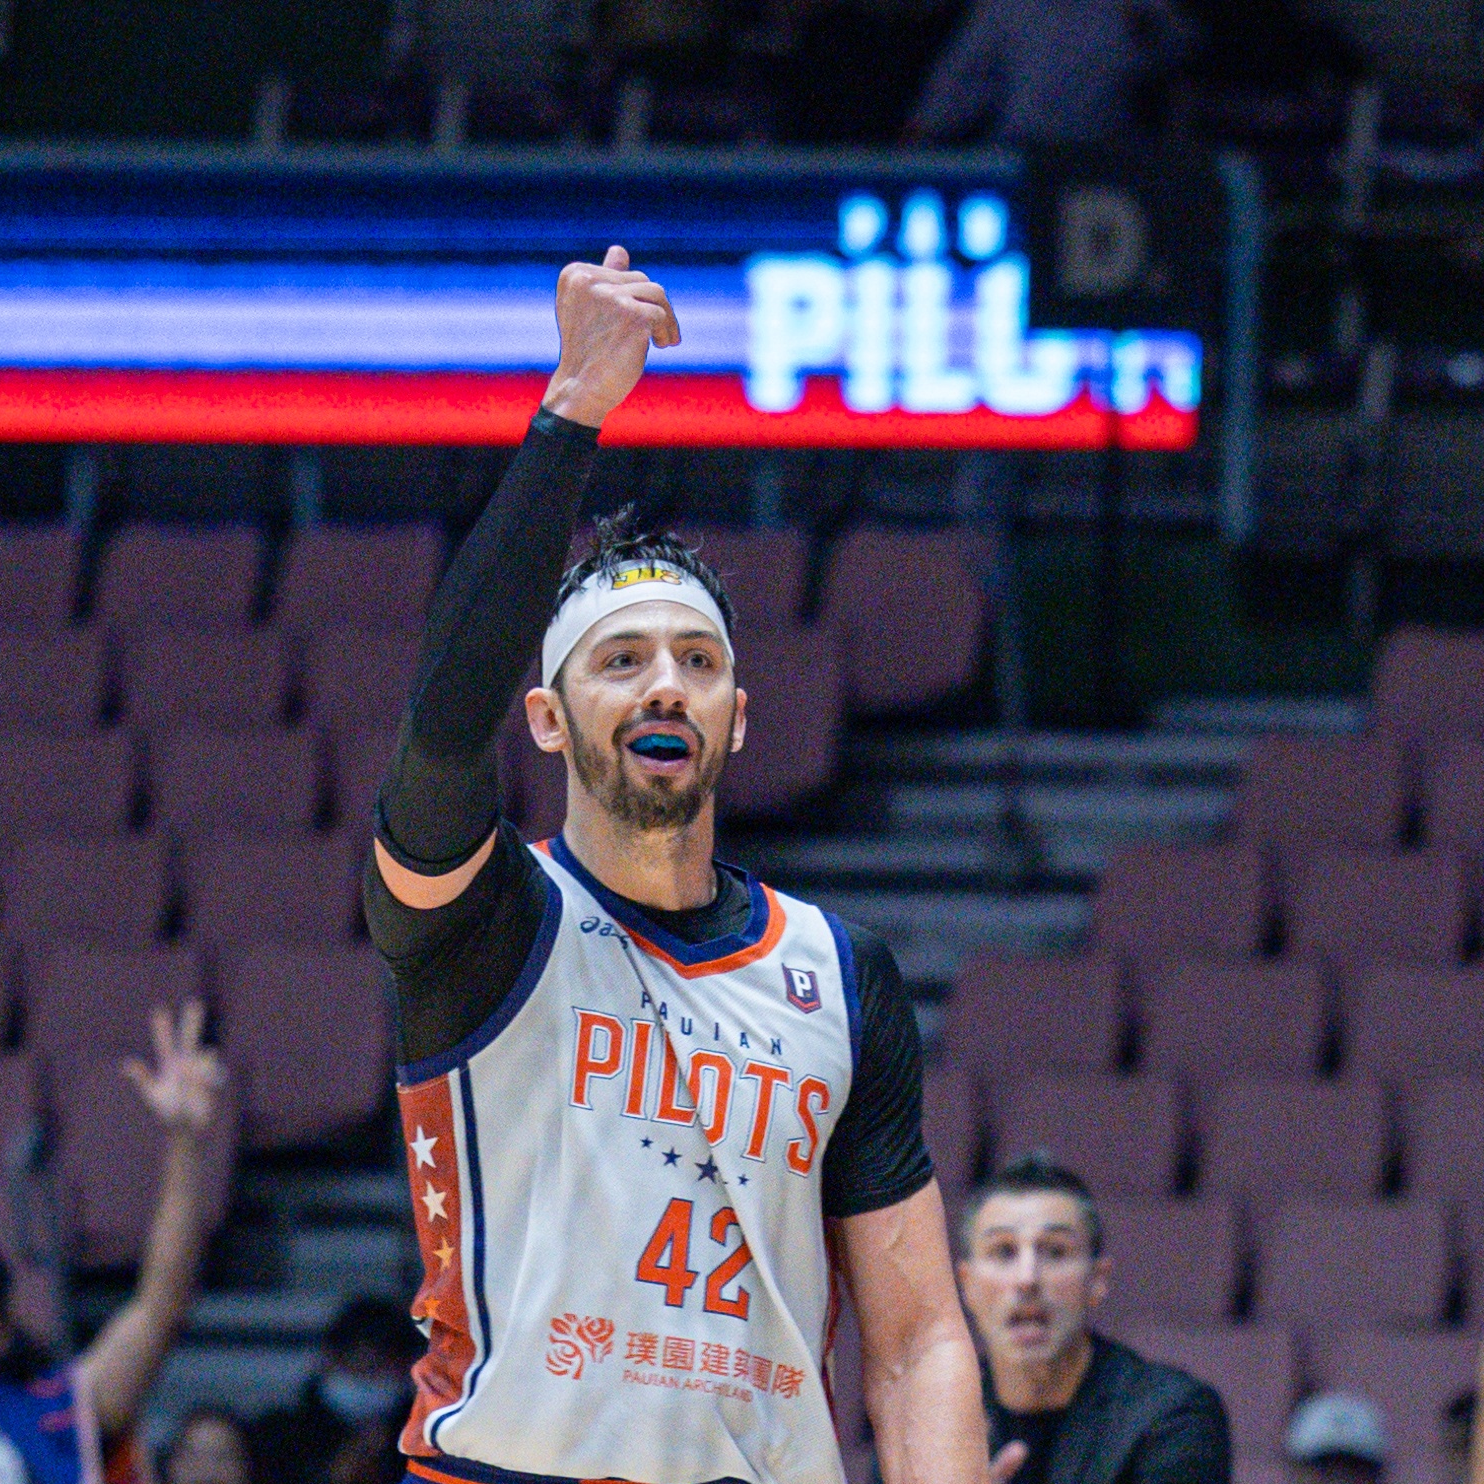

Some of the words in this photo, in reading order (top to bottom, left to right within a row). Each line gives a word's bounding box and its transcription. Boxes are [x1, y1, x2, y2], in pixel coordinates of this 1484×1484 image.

[640, 991, 784, 1056] PAUIAN
[790, 969, 813, 998] P
[570, 1005, 830, 1178] PILOTS
[635, 1197, 750, 1321] 42
